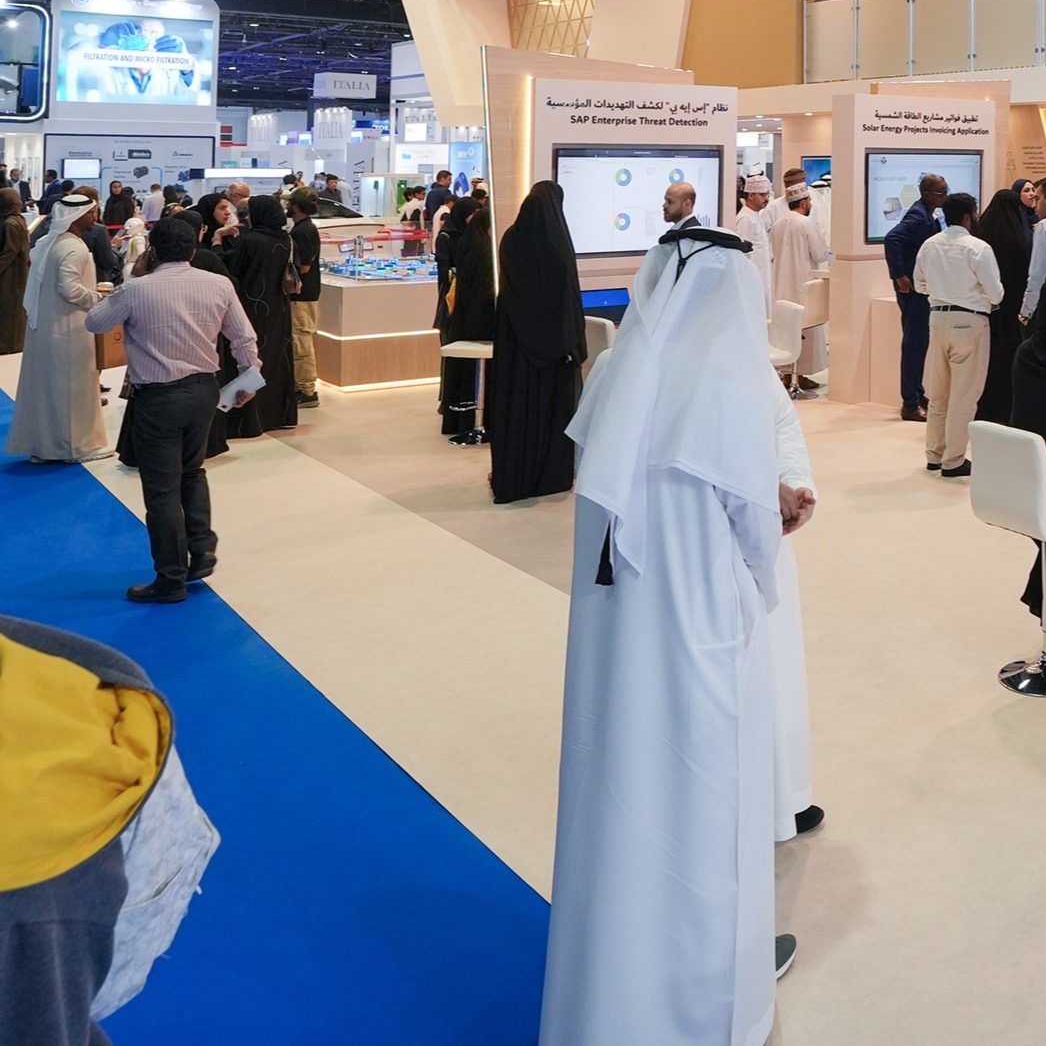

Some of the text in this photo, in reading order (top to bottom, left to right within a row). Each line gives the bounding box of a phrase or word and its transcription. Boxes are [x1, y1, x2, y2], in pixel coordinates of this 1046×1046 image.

[84, 53, 118, 61] FILTRATION
[120, 54, 133, 62] AND
[135, 55, 155, 63] MICRO
[333, 80, 370, 90] ITALIA
[594, 99, 635, 111] التهديدات
[636, 101, 663, 111] لكشف
[711, 103, 729, 115] نظام
[570, 115, 708, 127] SAP Enterprise Threat Detection
[862, 124, 989, 136] Solar Energy Projects Invoicing Application
